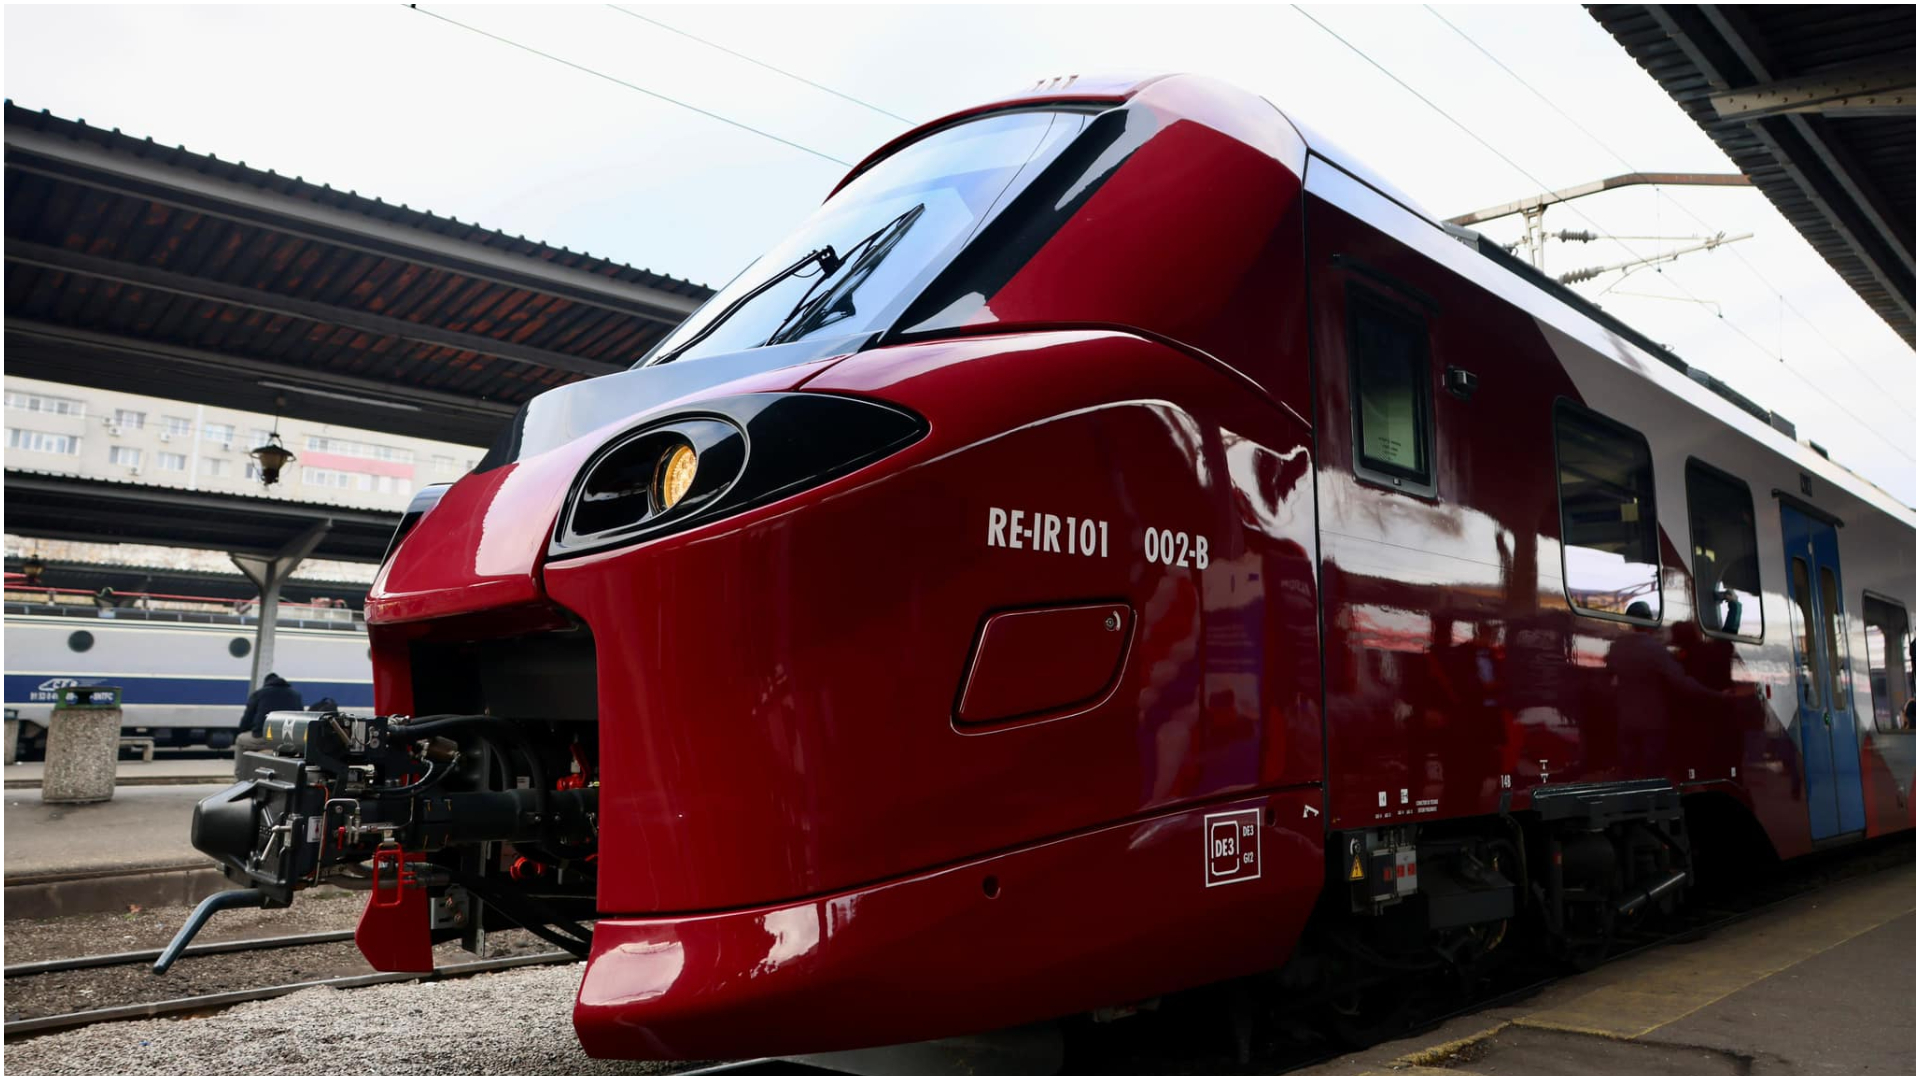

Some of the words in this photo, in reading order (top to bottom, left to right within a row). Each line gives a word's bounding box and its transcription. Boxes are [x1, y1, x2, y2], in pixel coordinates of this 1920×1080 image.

[1144, 526, 1209, 570] 002-B
[1242, 825, 1254, 837] DE3
[1215, 837, 1235, 858] DE3
